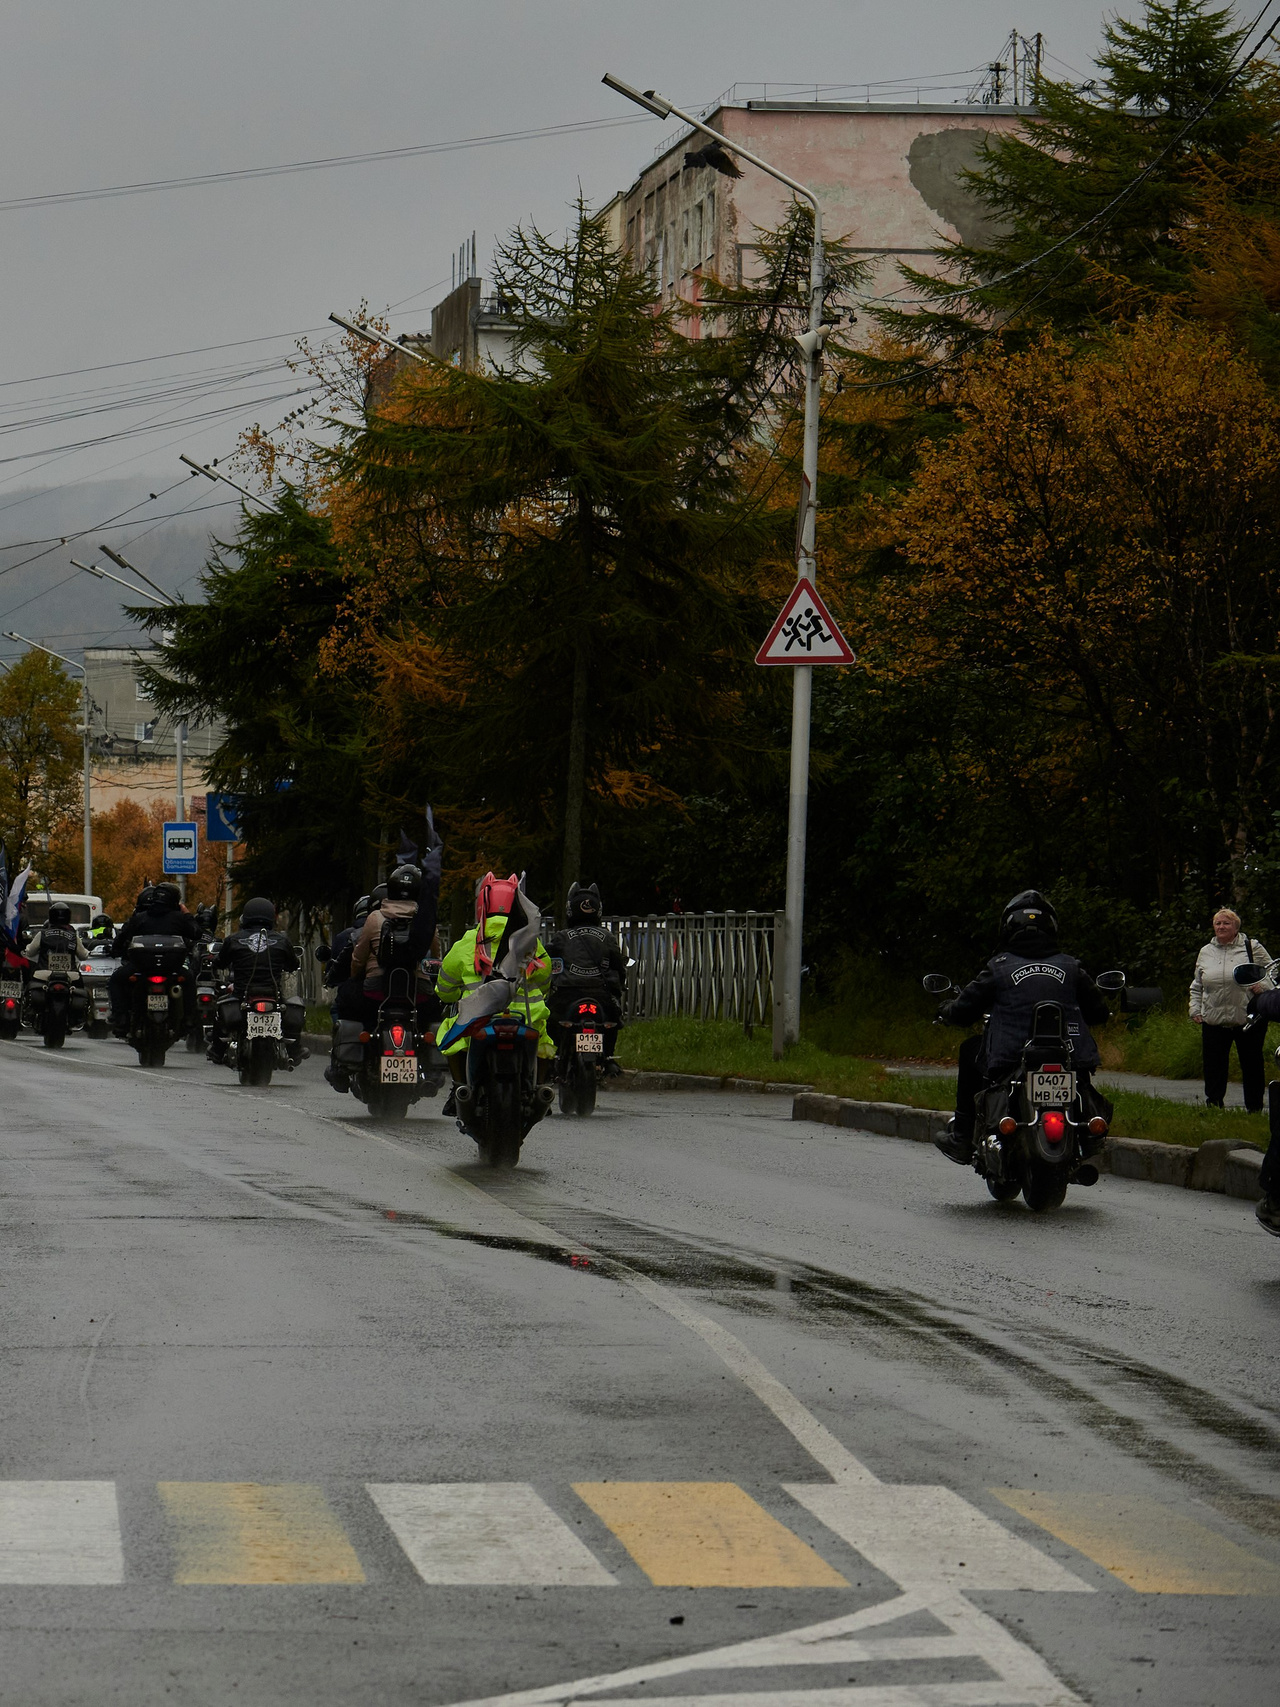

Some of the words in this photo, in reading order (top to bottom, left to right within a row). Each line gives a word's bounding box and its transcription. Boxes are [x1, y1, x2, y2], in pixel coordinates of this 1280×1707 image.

[570, 929, 589, 937] POAR
[1014, 966, 1041, 980] POLAR
[1041, 966, 1064, 979] OWLS
[253, 1015, 275, 1024] 0137
[267, 1025, 278, 1034] 49
[579, 1034, 599, 1042] 0119
[591, 1044, 602, 1052] 49
[386, 1059, 412, 1069] 0011
[402, 1072, 415, 1082] 49
[1038, 1075, 1066, 1086] 0407
[1055, 1091, 1069, 1101] 49
